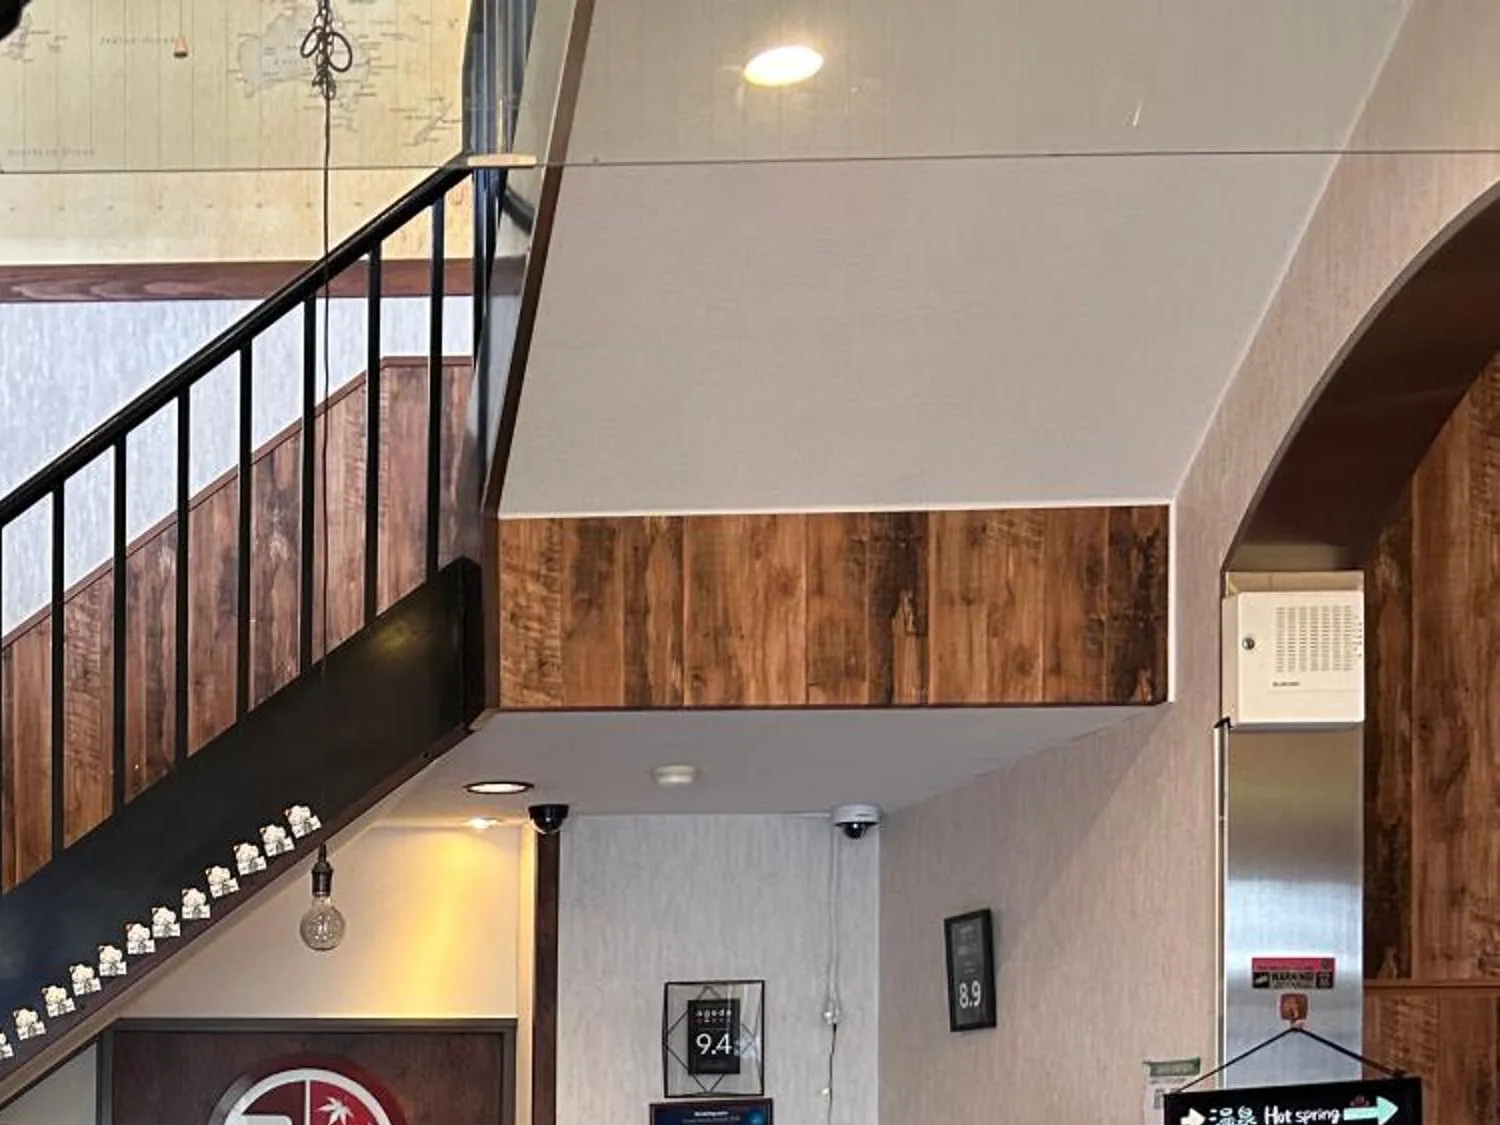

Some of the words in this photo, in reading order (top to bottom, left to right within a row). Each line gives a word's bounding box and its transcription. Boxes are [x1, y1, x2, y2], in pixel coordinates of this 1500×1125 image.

[959, 981, 981, 1008] 8.9
[695, 1033, 733, 1055] 9.4
[1264, 1105, 1293, 1125] Hot
[1295, 1108, 1341, 1125] spring
